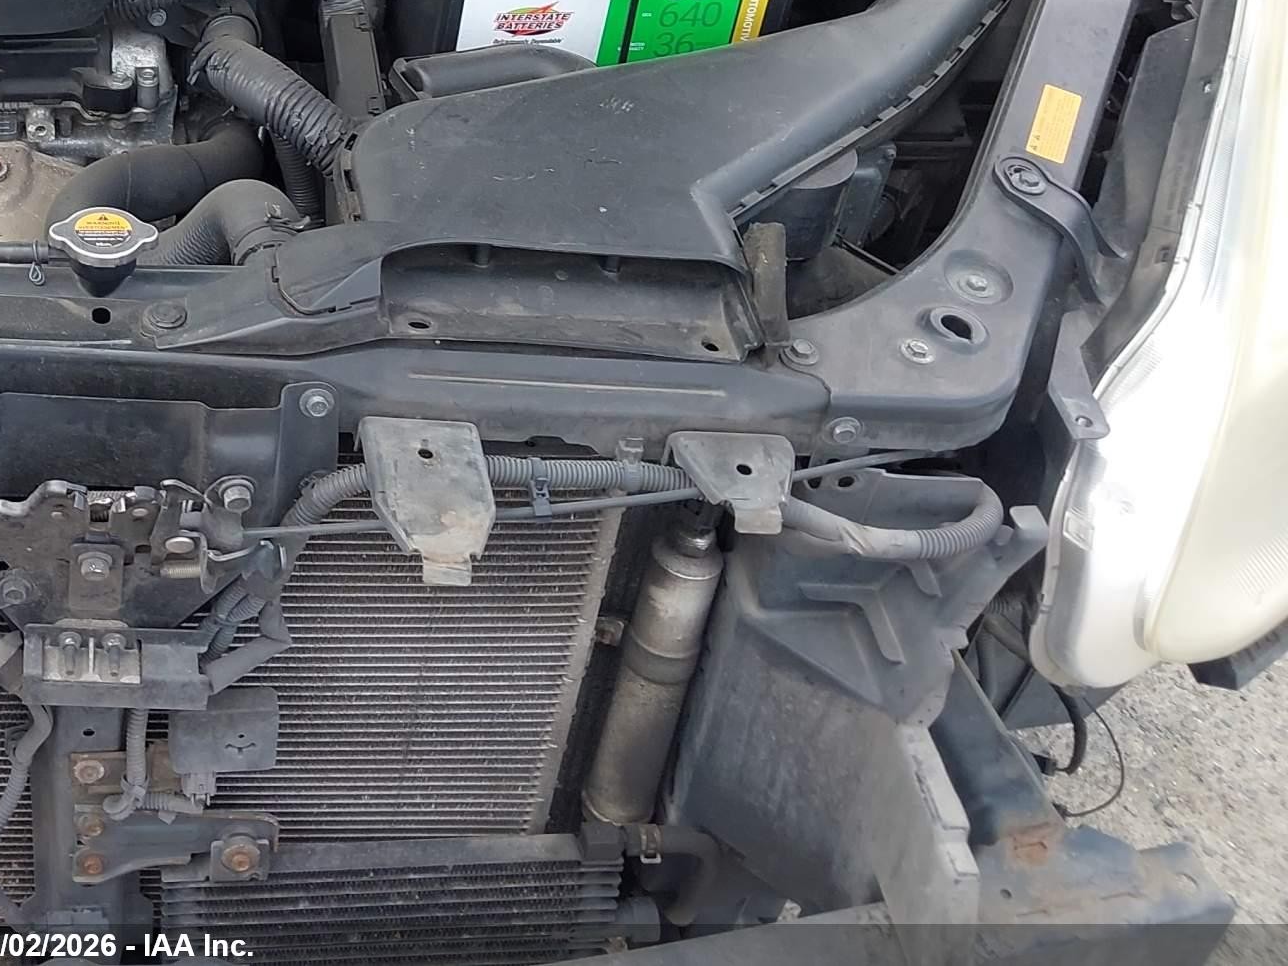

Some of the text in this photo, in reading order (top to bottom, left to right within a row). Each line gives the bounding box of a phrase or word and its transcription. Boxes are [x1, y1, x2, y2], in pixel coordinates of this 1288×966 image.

[495, 13, 572, 21] INTERSTATE
[658, 1, 723, 28] 640
[496, 22, 564, 30] BATTERIES
[652, 32, 694, 57] 36
